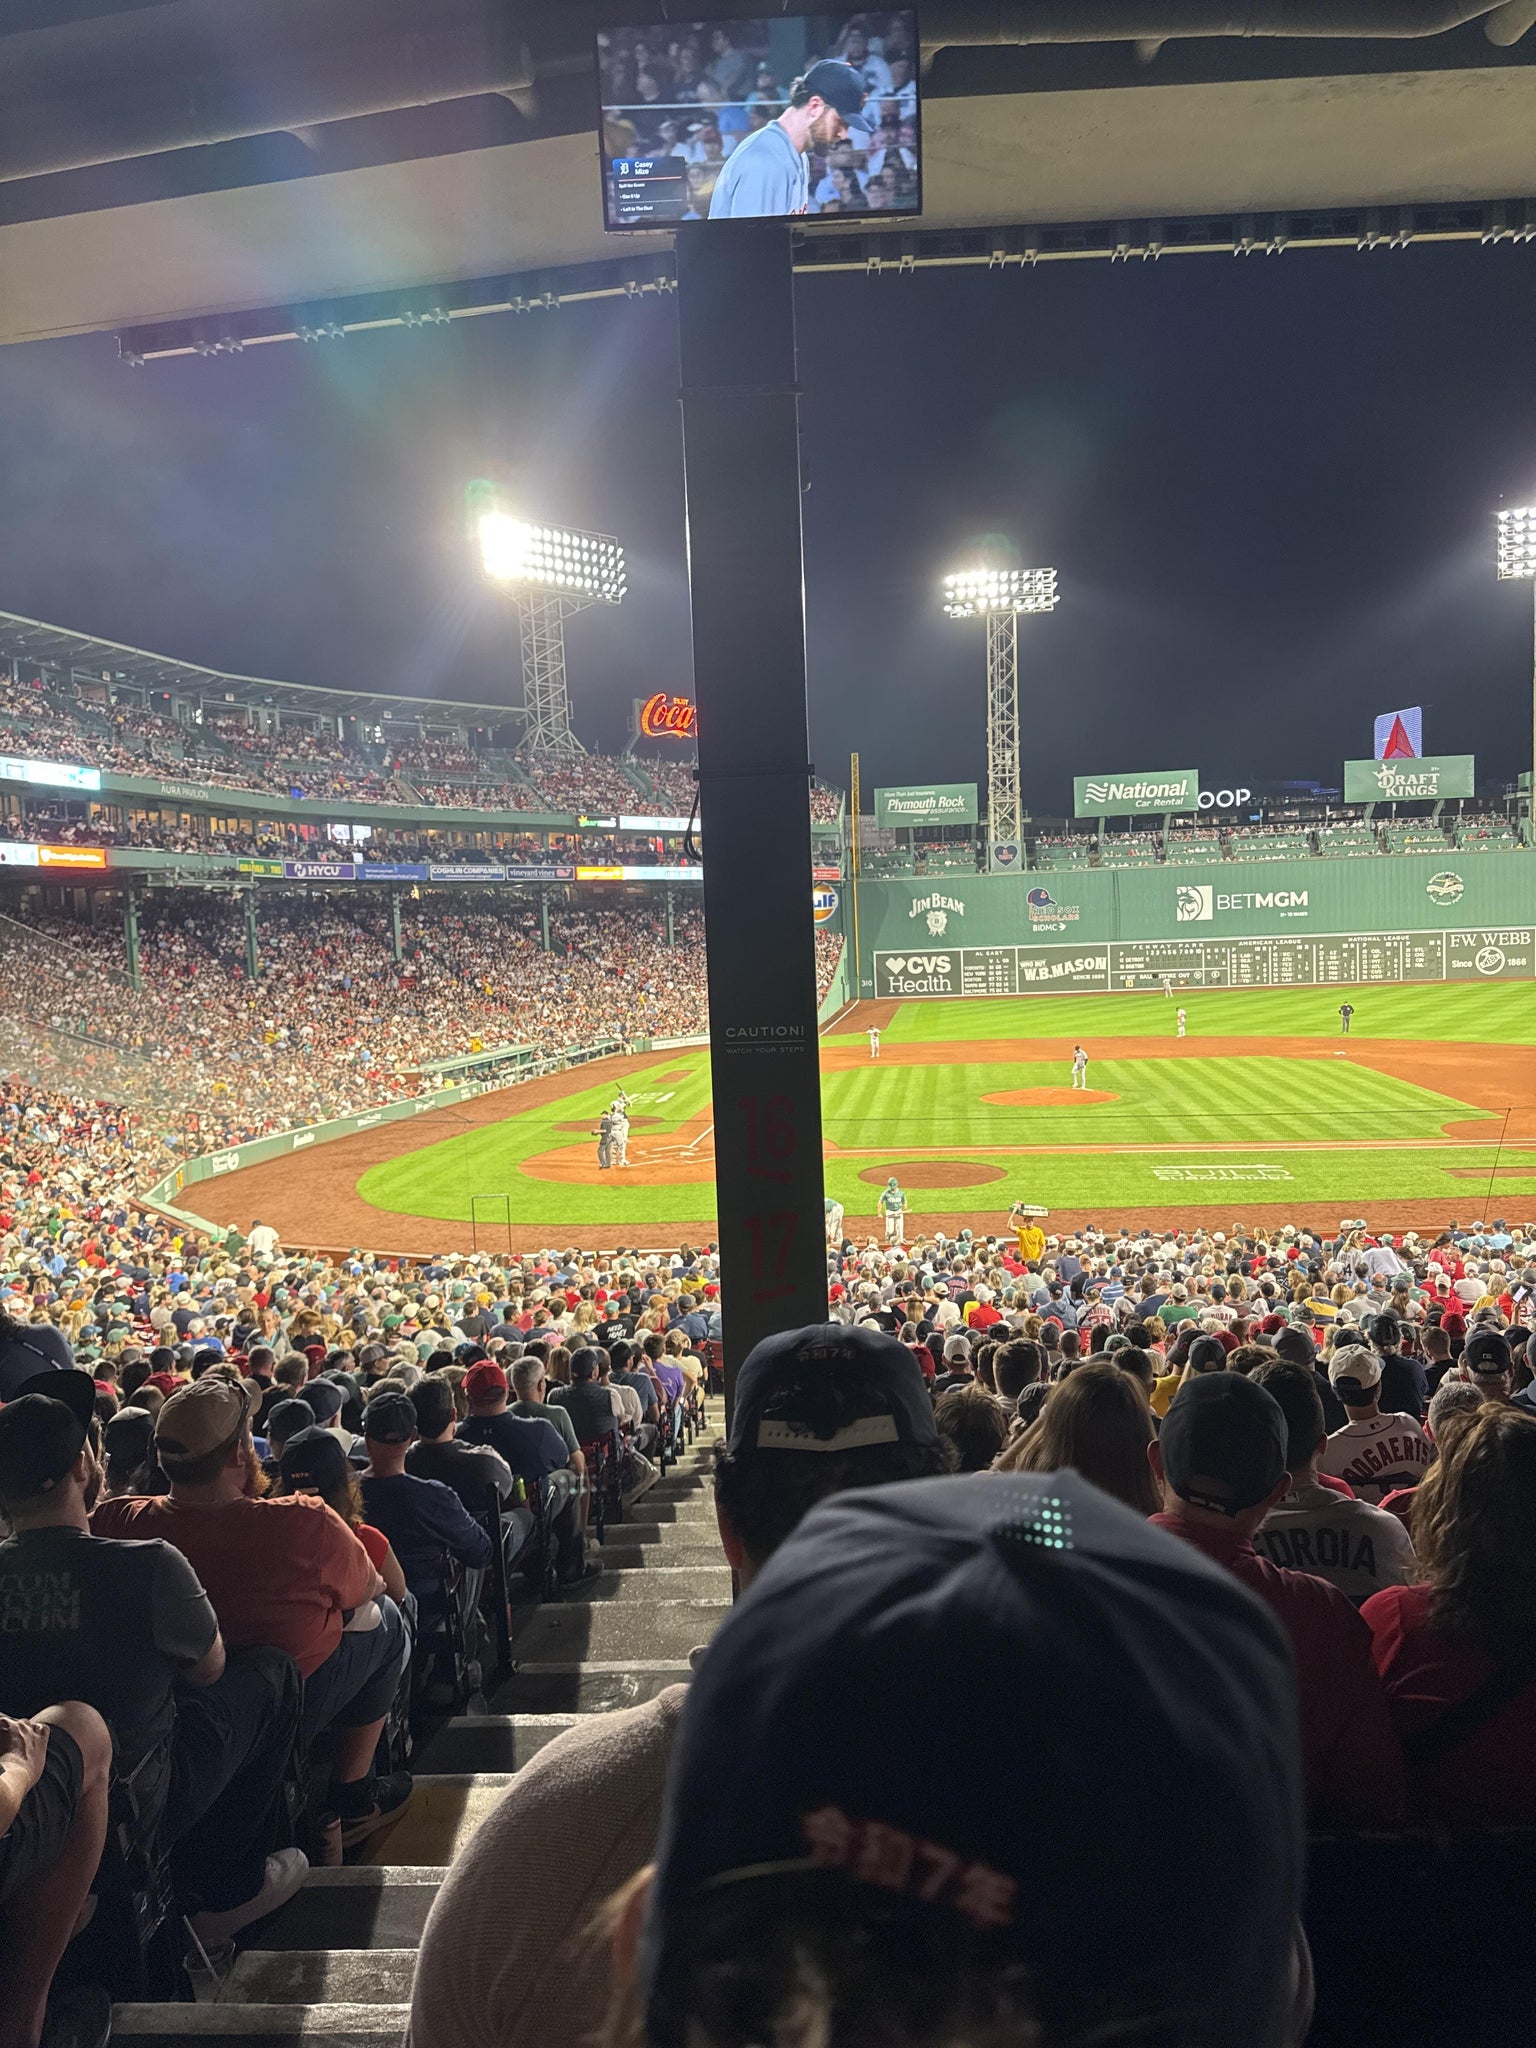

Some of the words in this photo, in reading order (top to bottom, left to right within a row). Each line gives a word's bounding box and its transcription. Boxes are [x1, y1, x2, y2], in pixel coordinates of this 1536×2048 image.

[641, 693, 695, 738] Coca
[1377, 773, 1440, 789] DRAFT
[1385, 785, 1438, 797] KINGS
[887, 797, 936, 811] Plymouth
[938, 795, 965, 808] Rock
[1135, 799, 1152, 808] Car
[1153, 797, 1184, 807] Rental
[308, 866, 340, 876] HYCU
[464, 866, 503, 874] COMPANIES
[509, 869, 538, 878] vineyard
[539, 868, 555, 877] vines
[909, 897, 931, 919] JIM
[931, 892, 965, 917] BEAM
[1217, 890, 1308, 910] BETMGM
[1032, 906, 1055, 915] RED
[1057, 905, 1080, 914] SOX
[1032, 913, 1080, 922] SCHOLARS
[1032, 923, 1058, 932] BIDMC
[1450, 934, 1478, 947] F.W.
[1481, 931, 1531, 946] WEBB
[906, 956, 952, 974] CVS
[1019, 961, 1034, 969] WHO
[1034, 959, 1047, 967] BUT
[1452, 959, 1473, 968] Since
[861, 979, 872, 987] 310
[888, 975, 952, 994] Health
[725, 1025, 805, 1038] CAUTION!
[738, 1094, 797, 1162] 16
[1153, 1169, 1290, 1177] BUILD
[744, 1212, 800, 1281] 17
[606, 1323, 623, 1333] NEED
[608, 1328, 627, 1340] MONEY
[1253, 1527, 1376, 1577] DROIA
